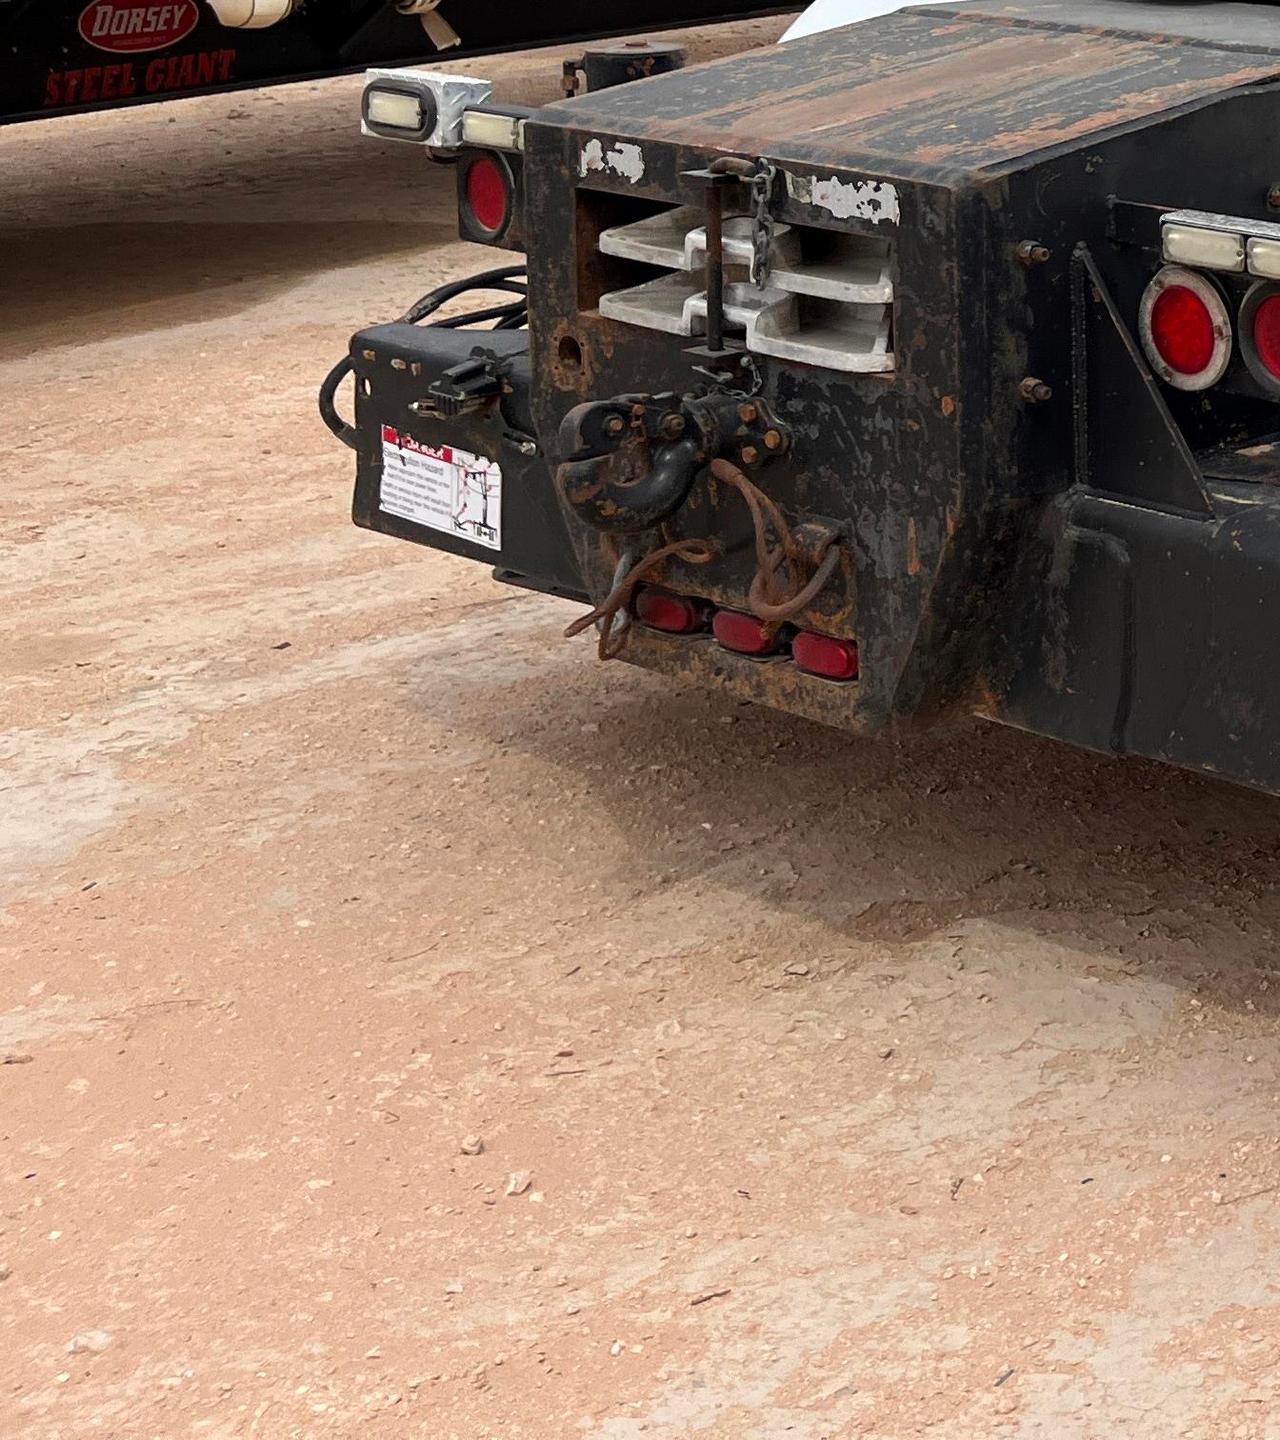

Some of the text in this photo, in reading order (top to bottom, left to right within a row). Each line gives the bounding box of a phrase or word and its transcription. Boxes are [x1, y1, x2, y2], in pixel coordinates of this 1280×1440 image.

[92, 4, 188, 37] DORSEY
[44, 48, 236, 107] STEEL GIANT
